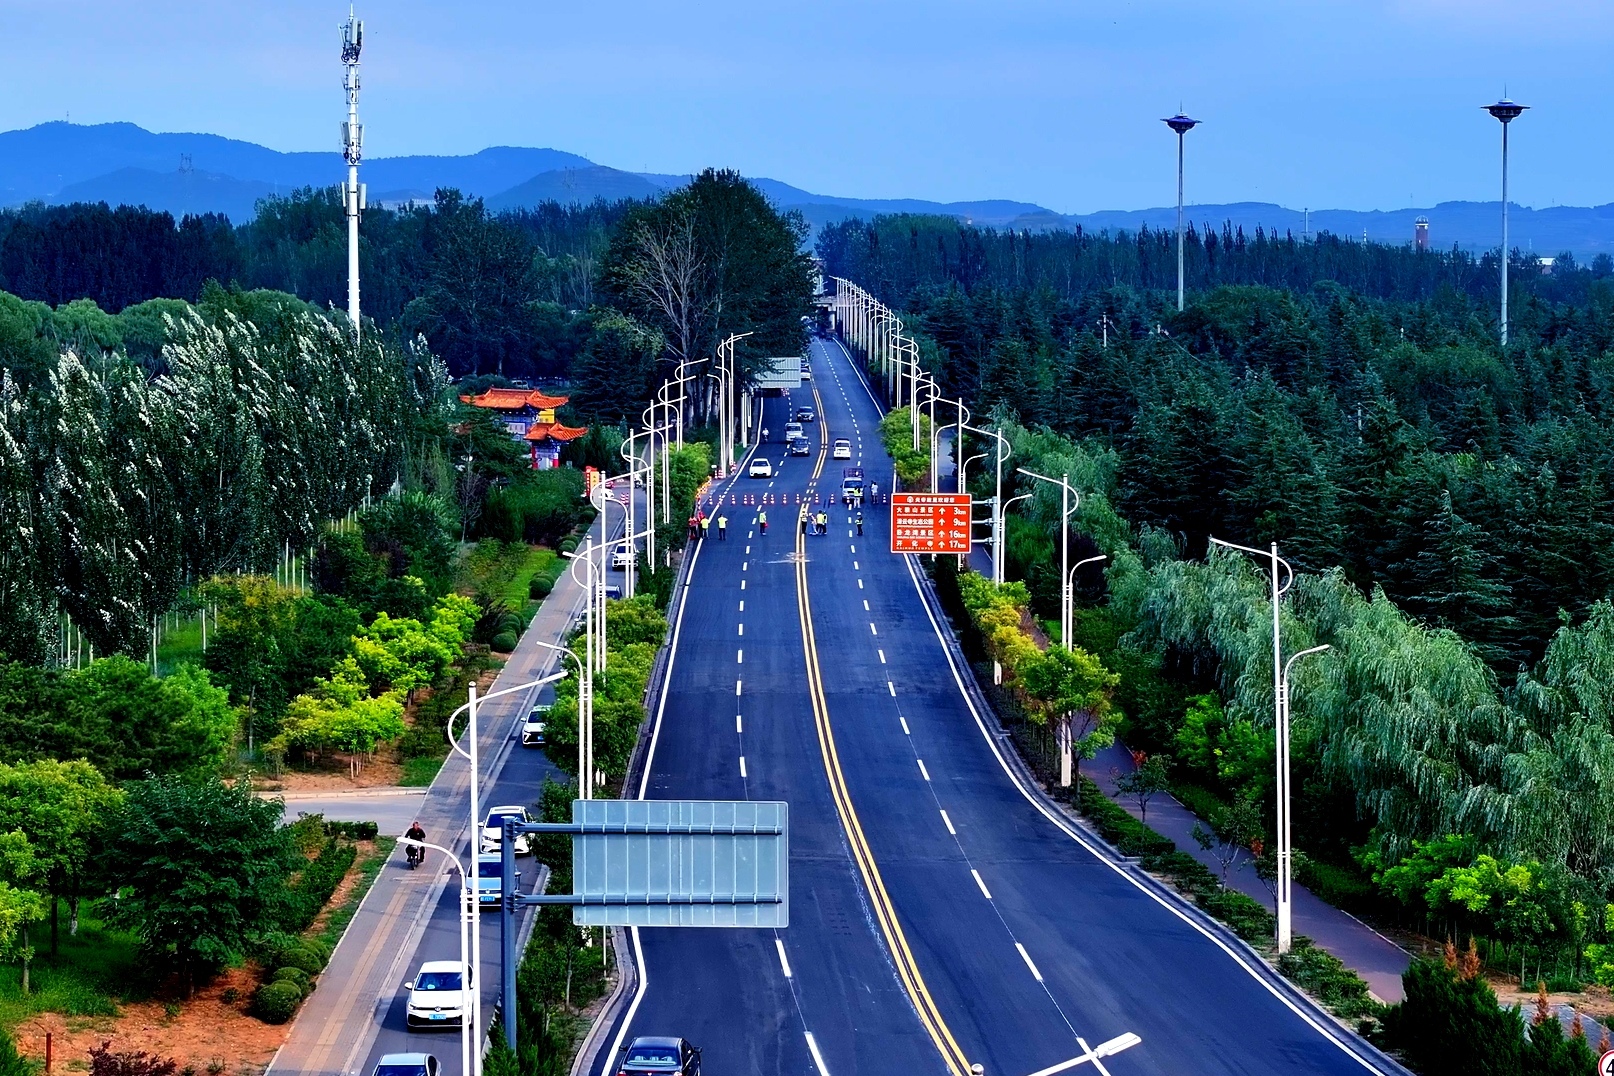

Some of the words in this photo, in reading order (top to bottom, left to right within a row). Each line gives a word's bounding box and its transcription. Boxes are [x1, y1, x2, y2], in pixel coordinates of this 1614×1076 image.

[953, 507, 966, 515] 3km
[953, 518, 966, 526] 9km
[949, 530, 966, 538] 16km
[949, 540, 966, 549] 17km
